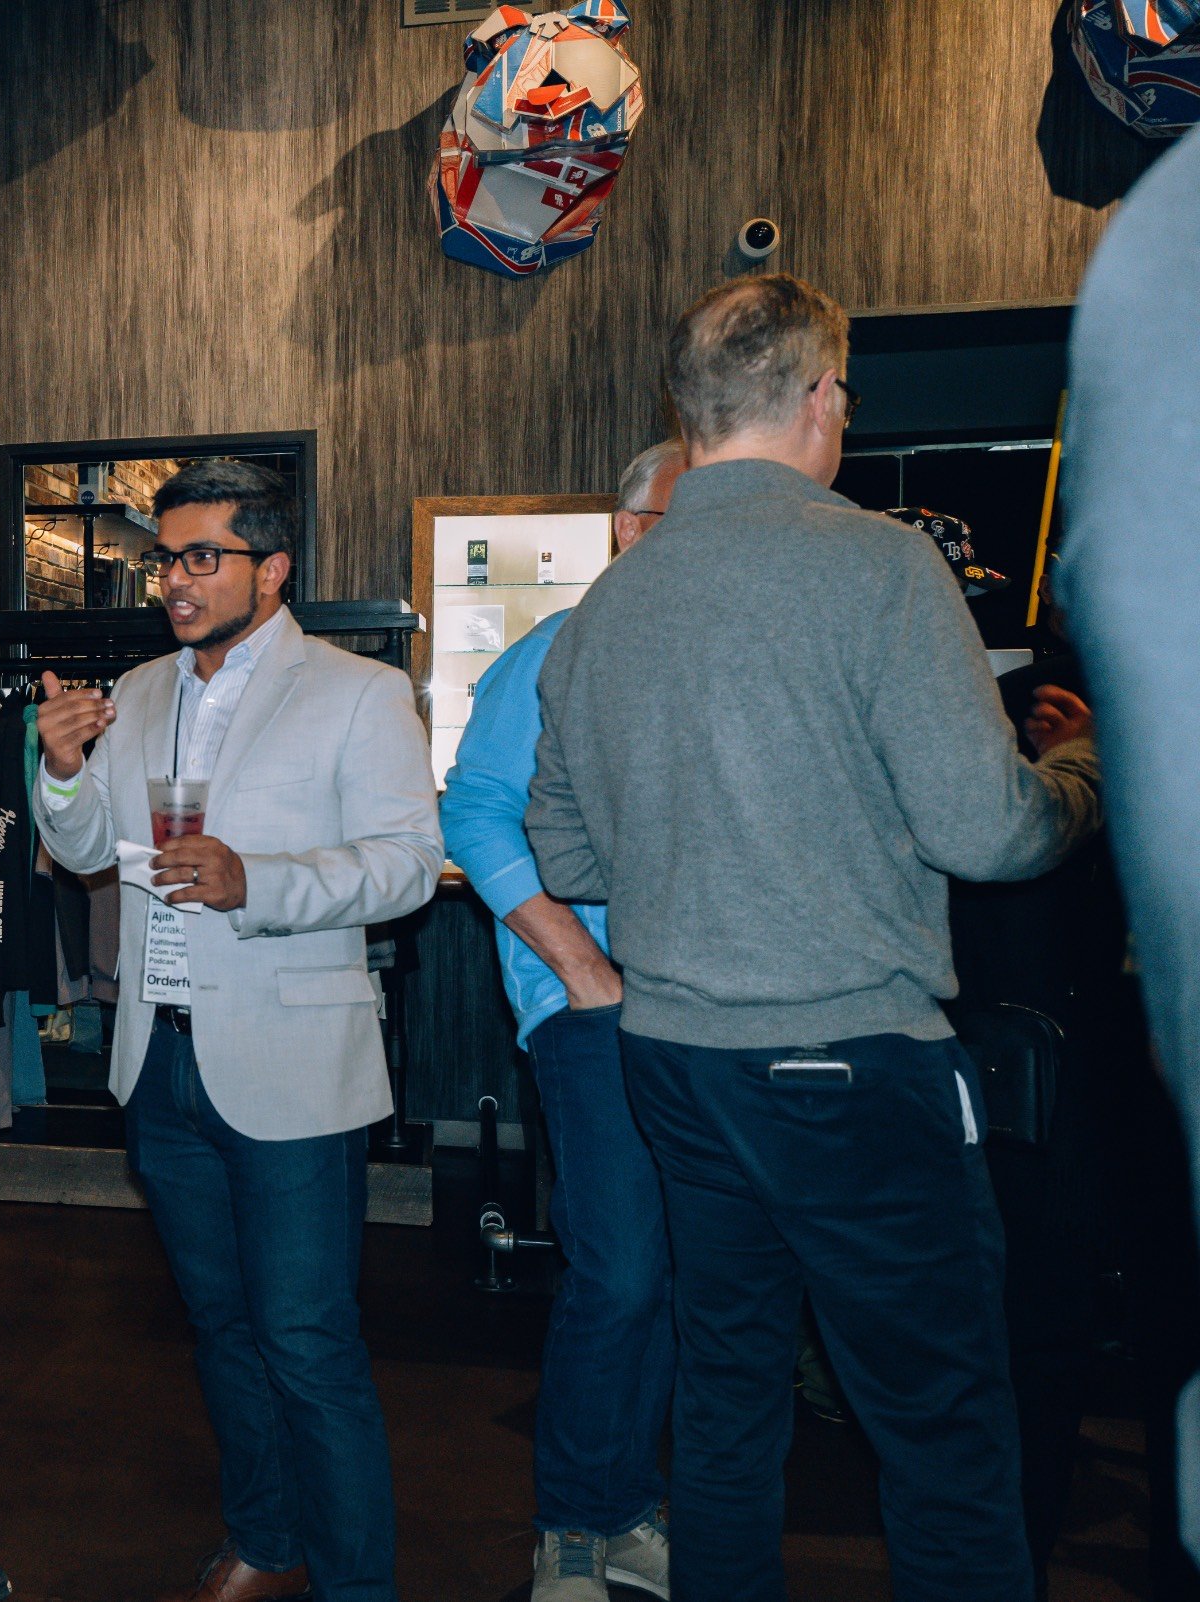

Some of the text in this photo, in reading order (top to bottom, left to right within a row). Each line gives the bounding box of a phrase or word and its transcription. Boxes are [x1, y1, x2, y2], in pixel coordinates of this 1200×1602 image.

[942, 541, 961, 560] TB
[152, 911, 175, 923] Ajith
[149, 957, 177, 966] Podcast
